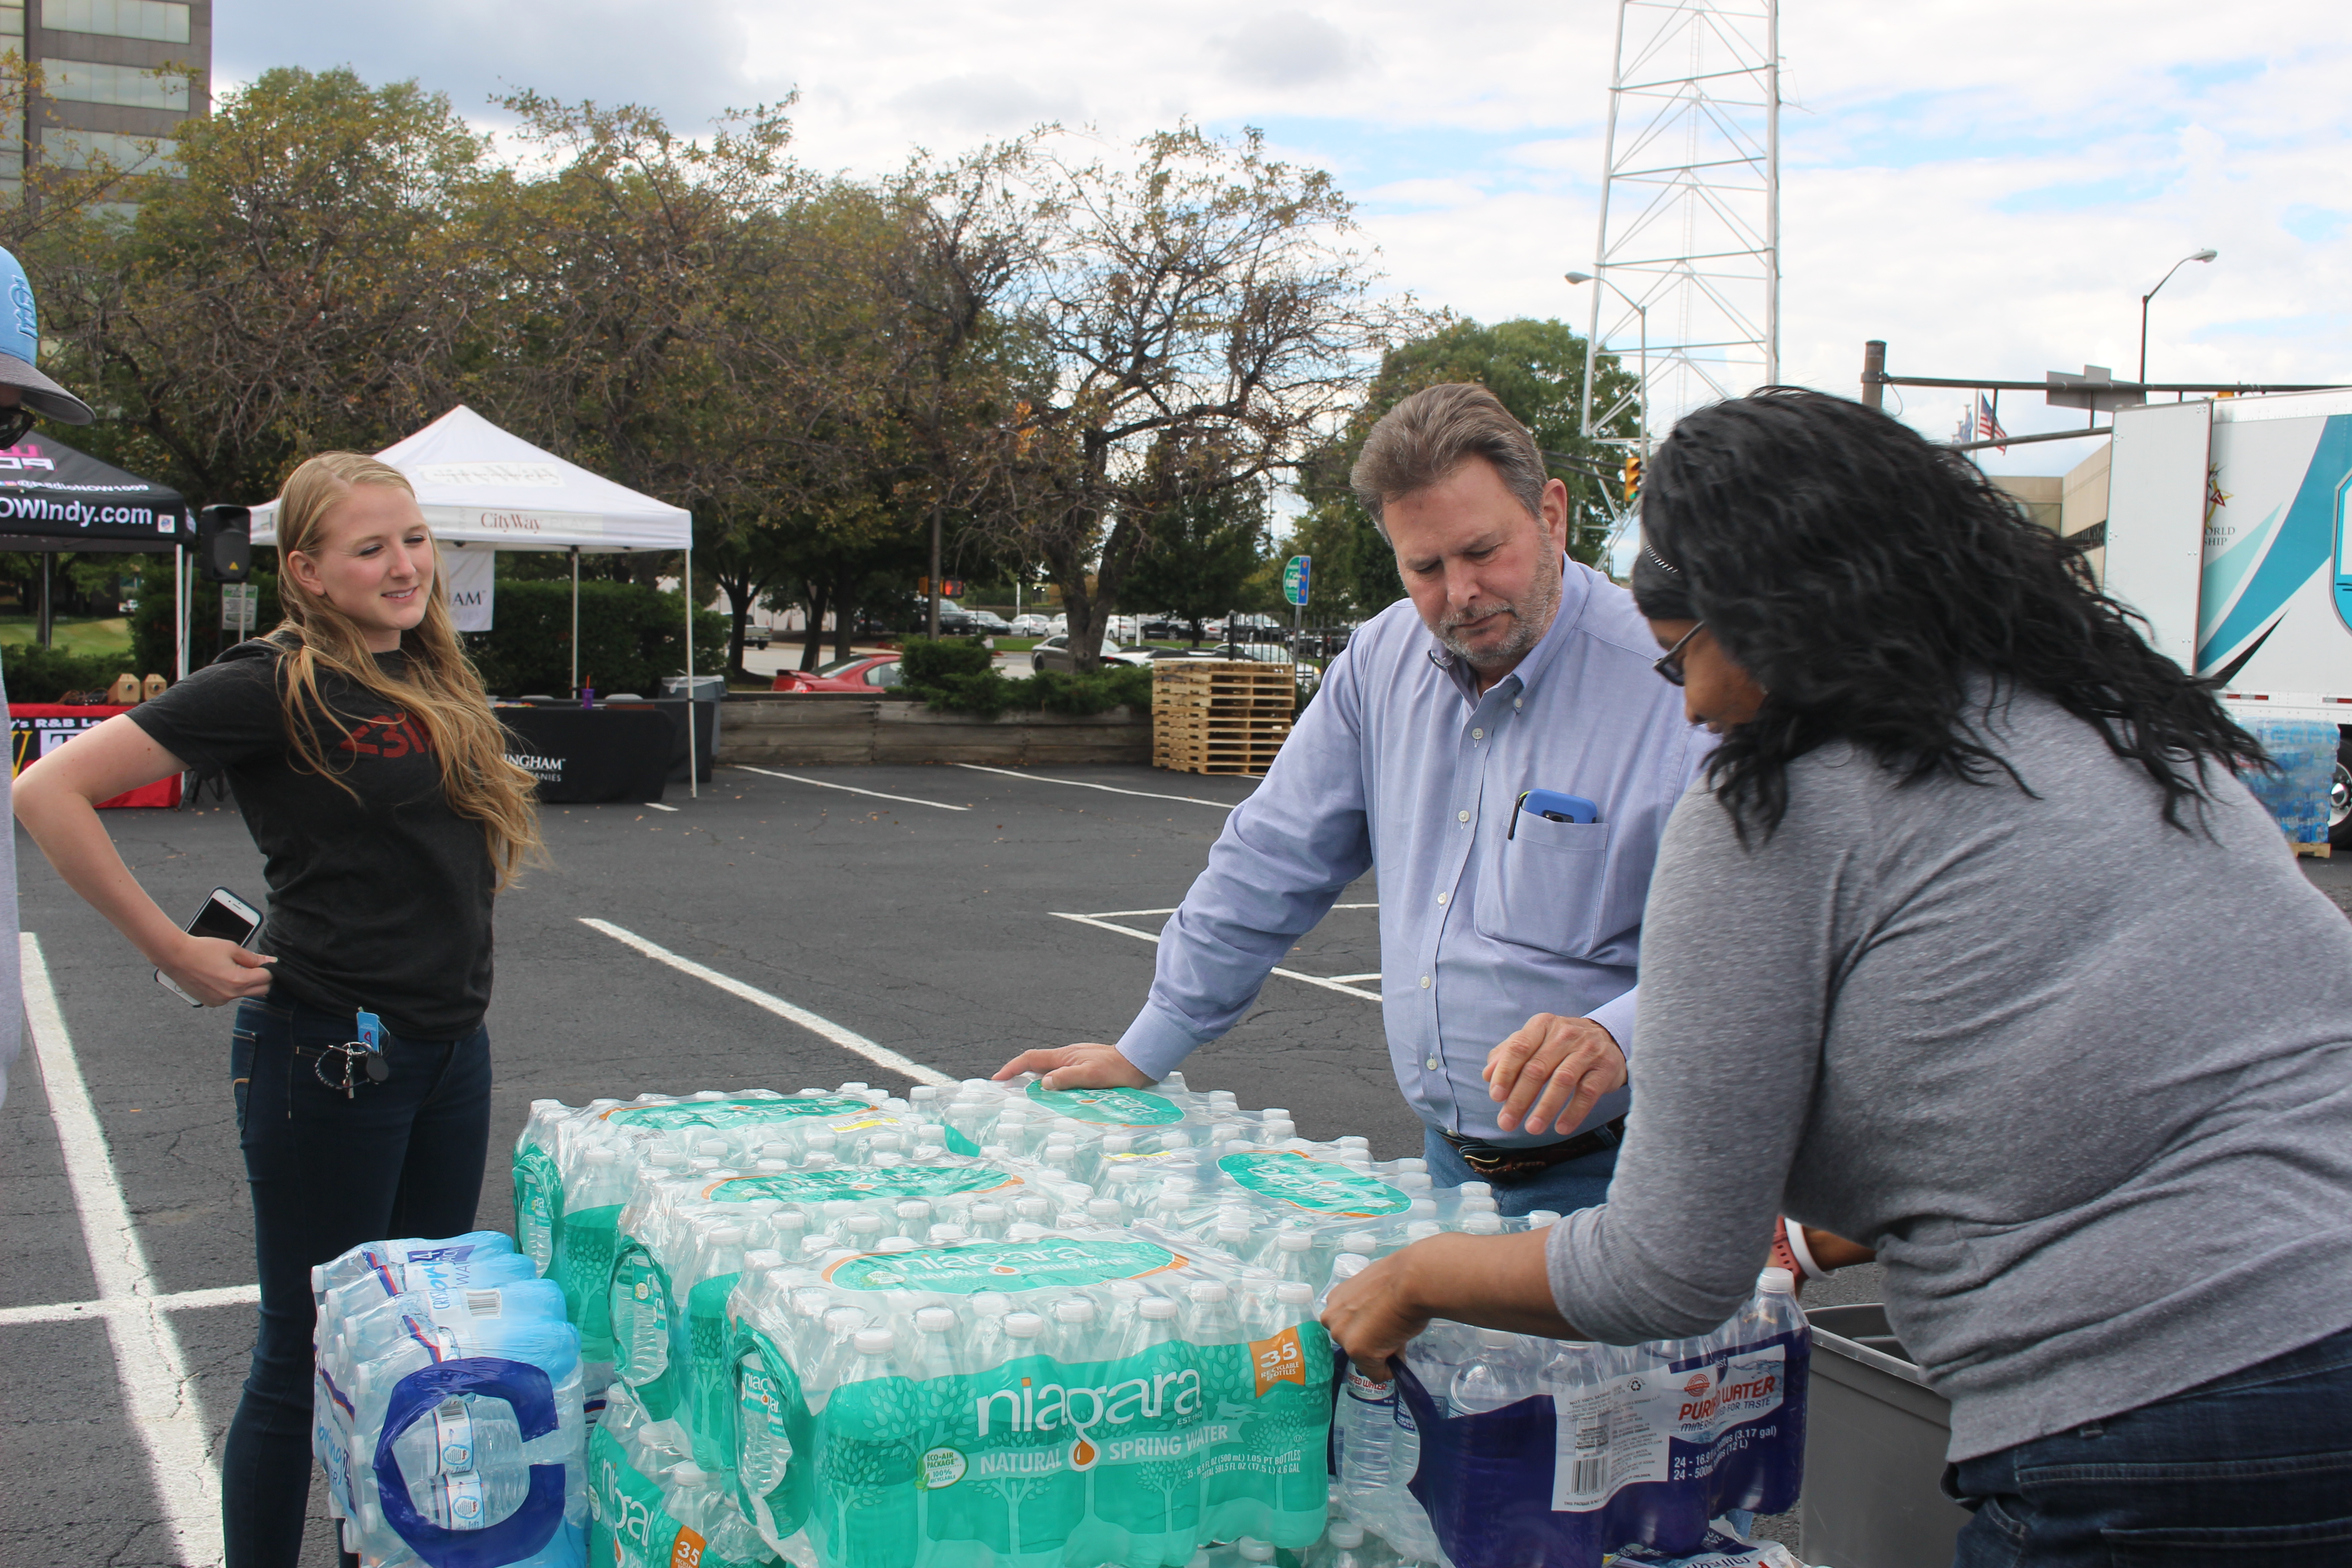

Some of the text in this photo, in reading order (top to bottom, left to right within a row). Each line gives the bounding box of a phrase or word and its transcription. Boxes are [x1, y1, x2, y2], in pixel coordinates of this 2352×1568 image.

[0, 497, 152, 528] OWIndy.com
[481, 511, 544, 534] CityWay
[2205, 526, 2235, 536] ORLD
[2204, 537, 2227, 546] SHIP
[35, 718, 76, 728] R&B
[504, 754, 563, 770] INGHAM
[534, 772, 562, 782] ANIES
[892, 1247, 1095, 1275] niagara
[912, 1269, 983, 1280] NATURAL
[431, 1289, 451, 1310] CRYST
[1260, 1342, 1298, 1368] 35
[1260, 1362, 1299, 1378] RECYCLABLE
[1266, 1368, 1296, 1382] BOTTLES
[1363, 1379, 1387, 1391] WATER
[1722, 1375, 1776, 1403] WATER
[1727, 1401, 1740, 1413] FOR
[1744, 1396, 1770, 1410] TASTE
[976, 1368, 1202, 1472] niagara
[980, 1425, 1228, 1475] NATURAL SPRING WATER
[1674, 1456, 1686, 1468] 24
[1695, 1451, 1711, 1466] 16.9
[1734, 1428, 1757, 1441] (3.17
[1759, 1425, 1777, 1439] gal)
[926, 1452, 954, 1461] ECO-AIR
[1187, 1470, 1193, 1479] 35
[1205, 1459, 1210, 1469] FL
[1211, 1456, 1217, 1466] OZ
[1218, 1453, 1231, 1464] (500
[1232, 1453, 1245, 1462] mL)
[1247, 1454, 1262, 1463] 1.05
[1264, 1456, 1273, 1465] PT
[1275, 1450, 1301, 1465] BOTTLES
[1673, 1469, 1686, 1480] 24
[1726, 1441, 1738, 1455] (12
[1740, 1439, 1749, 1449] L)
[933, 1469, 952, 1478] 100%
[1201, 1468, 1214, 1480] TOTAL
[1215, 1462, 1229, 1474] 591.5
[1230, 1461, 1236, 1470] FL
[1248, 1462, 1267, 1472] (17.5
[1269, 1465, 1276, 1475] L)
[1278, 1464, 1288, 1475] 4.6
[1289, 1463, 1301, 1473] GAL
[677, 1541, 700, 1566] 35
